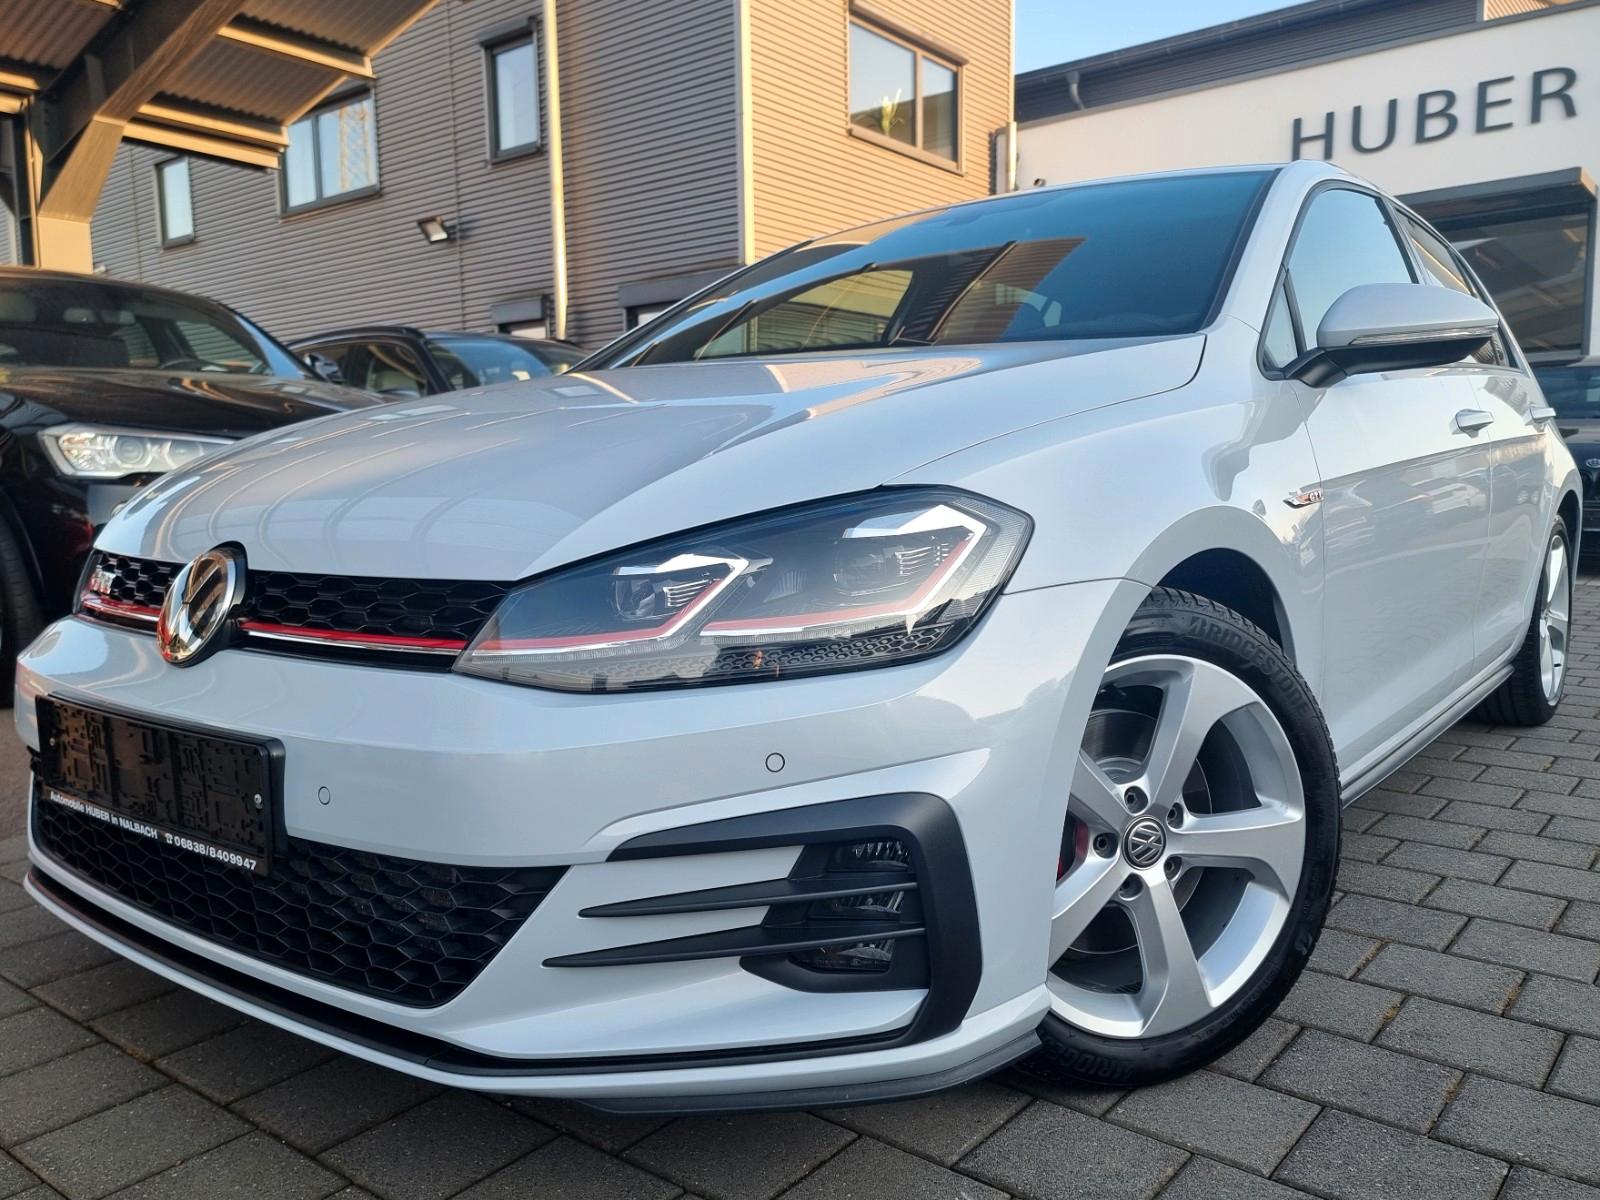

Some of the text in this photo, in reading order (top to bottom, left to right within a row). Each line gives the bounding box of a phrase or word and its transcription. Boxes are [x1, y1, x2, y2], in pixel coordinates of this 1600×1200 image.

[1292, 67, 1577, 161] HUBER
[1189, 614, 1312, 718] BRIDGESTONE
[85, 804, 110, 823] HUBER
[110, 814, 119, 825] in
[119, 817, 158, 840] NALBACH
[174, 836, 256, 870] 06838/8409947
